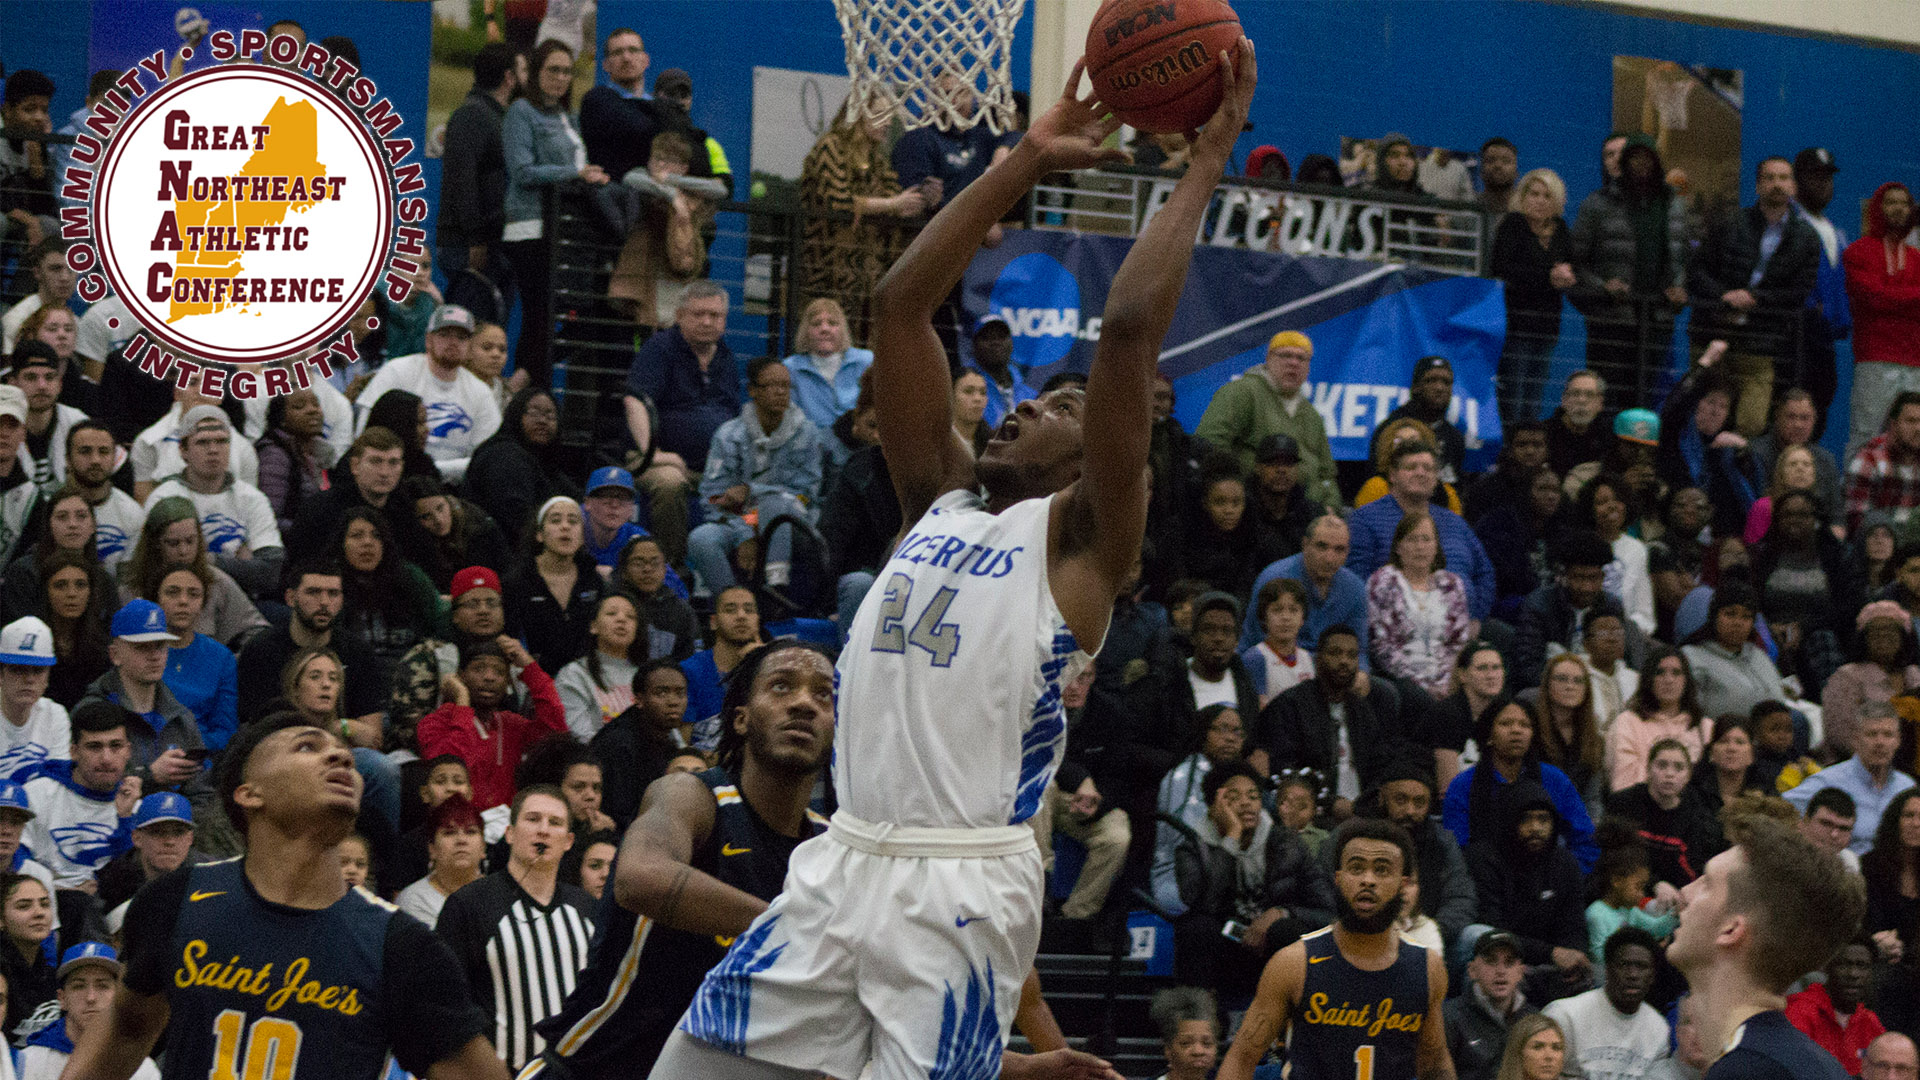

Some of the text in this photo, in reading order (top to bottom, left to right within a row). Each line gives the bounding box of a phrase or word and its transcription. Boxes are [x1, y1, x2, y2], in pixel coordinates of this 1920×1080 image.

[1105, 3, 1177, 47] NCAA
[1109, 40, 1213, 92] Wilson
[870, 572, 962, 669] 24
[175, 939, 364, 1016] Saint Joe's
[1304, 992, 1372, 1028] Saint
[208, 1008, 304, 1080] 10
[1353, 1045, 1376, 1080] 1
